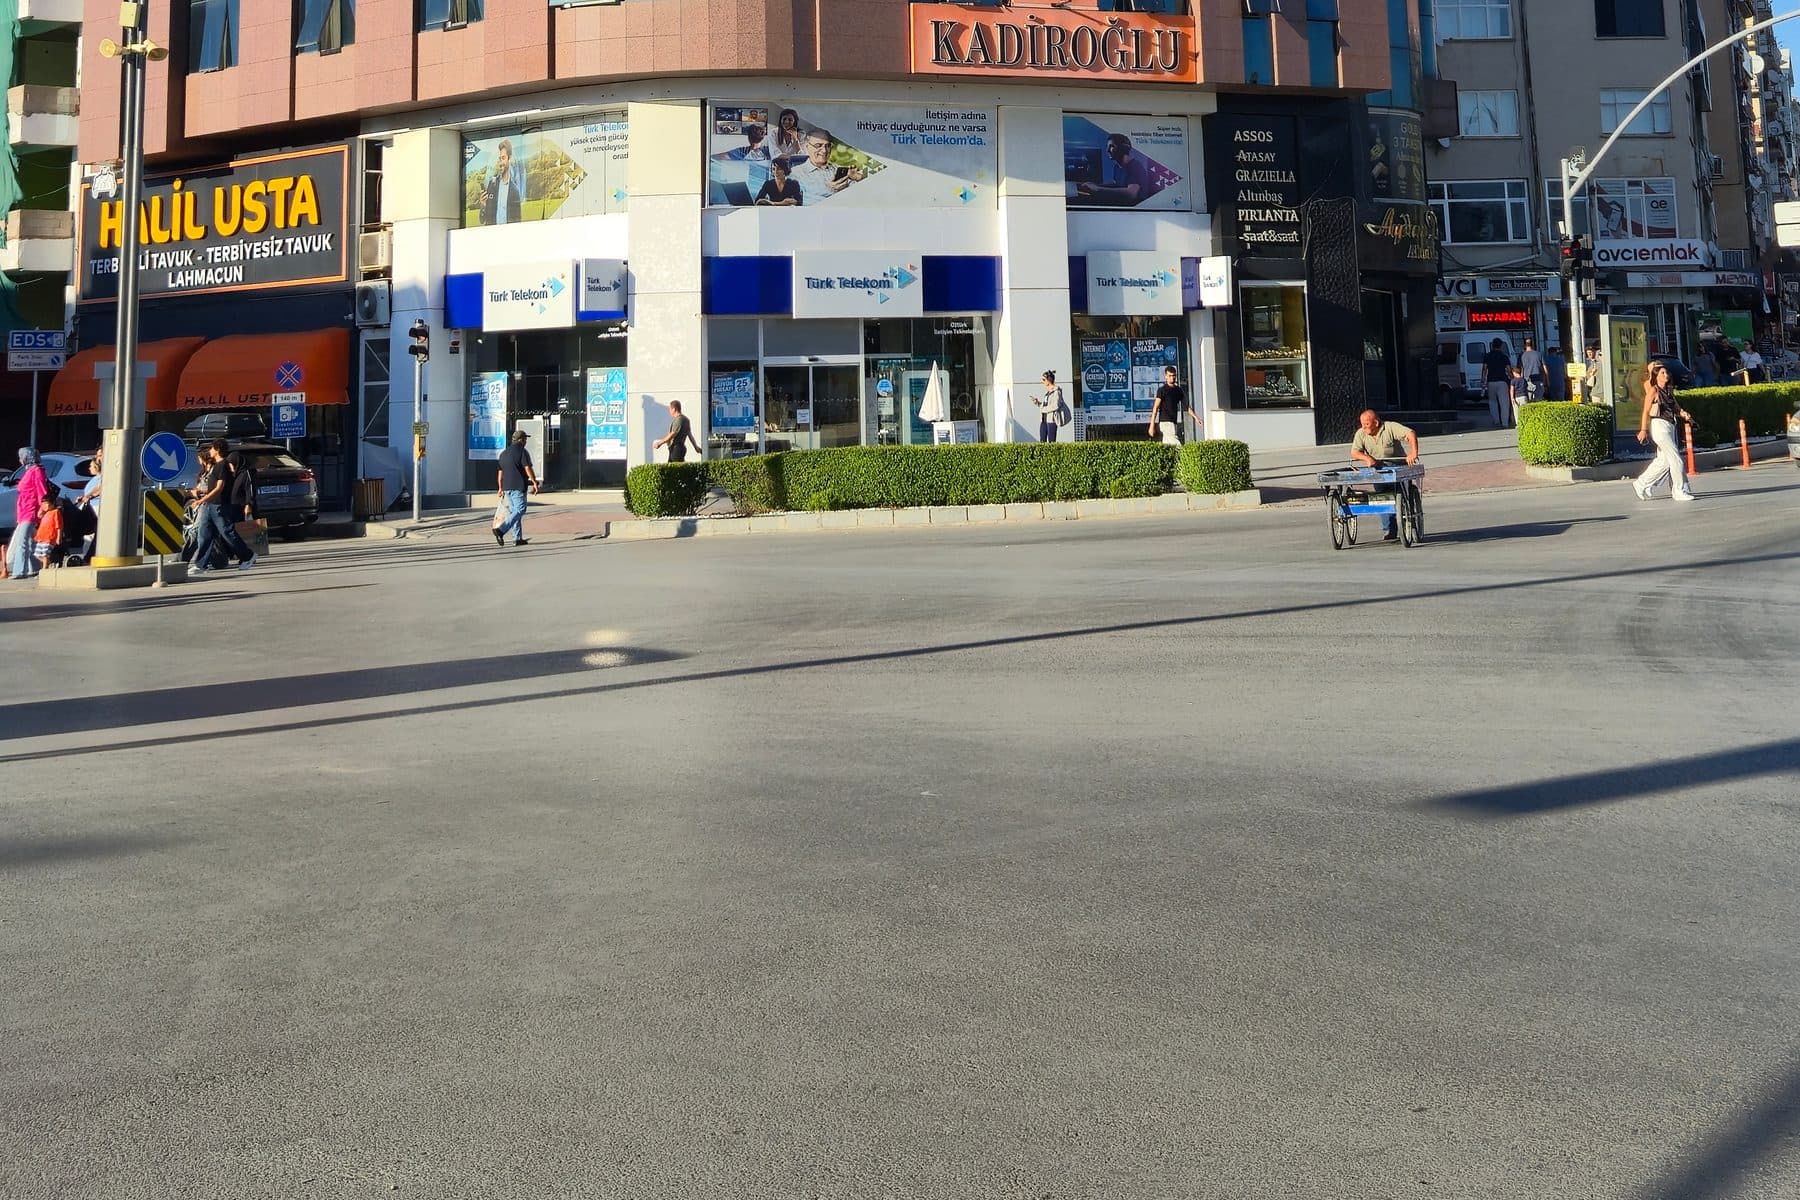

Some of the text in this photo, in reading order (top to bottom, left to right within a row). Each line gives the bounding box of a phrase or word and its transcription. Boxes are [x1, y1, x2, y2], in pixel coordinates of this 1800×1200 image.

[929, 13, 1182, 74] KADİROĞLU
[925, 109, 987, 122] İletişim adına
[600, 122, 629, 132] Teleko
[857, 121, 889, 133] ihtiyaç
[890, 122, 946, 133] duyduğunuz
[608, 132, 629, 142] gücüy
[891, 133, 919, 145] Türk
[1234, 130, 1273, 142] ASSOS
[592, 143, 629, 152] neredeysen
[612, 152, 629, 160] orad
[1235, 169, 1296, 183] GRAZIELLA
[1237, 189, 1283, 204] Altınbaş
[214, 174, 320, 237] USTA
[1237, 209, 1299, 222] PIRLANTA
[90, 250, 149, 275] TERBLİ
[152, 249, 193, 270] TAVUK
[207, 235, 283, 264] TERBİYESİZ
[285, 232, 333, 257] TAVUK
[168, 265, 244, 288] LAHMACUN
[587, 276, 600, 284] Türk
[805, 276, 891, 290] Türk Telekom
[1096, 277, 1158, 288] Türk Telekom
[587, 284, 612, 292] Telekom
[489, 288, 548, 302] Türk Telekom
[12, 333, 47, 347] EDS
[490, 383, 501, 395] 25
[736, 378, 748, 388] 25
[54, 399, 96, 412] HALİL
[184, 392, 271, 406] HALİL UST
